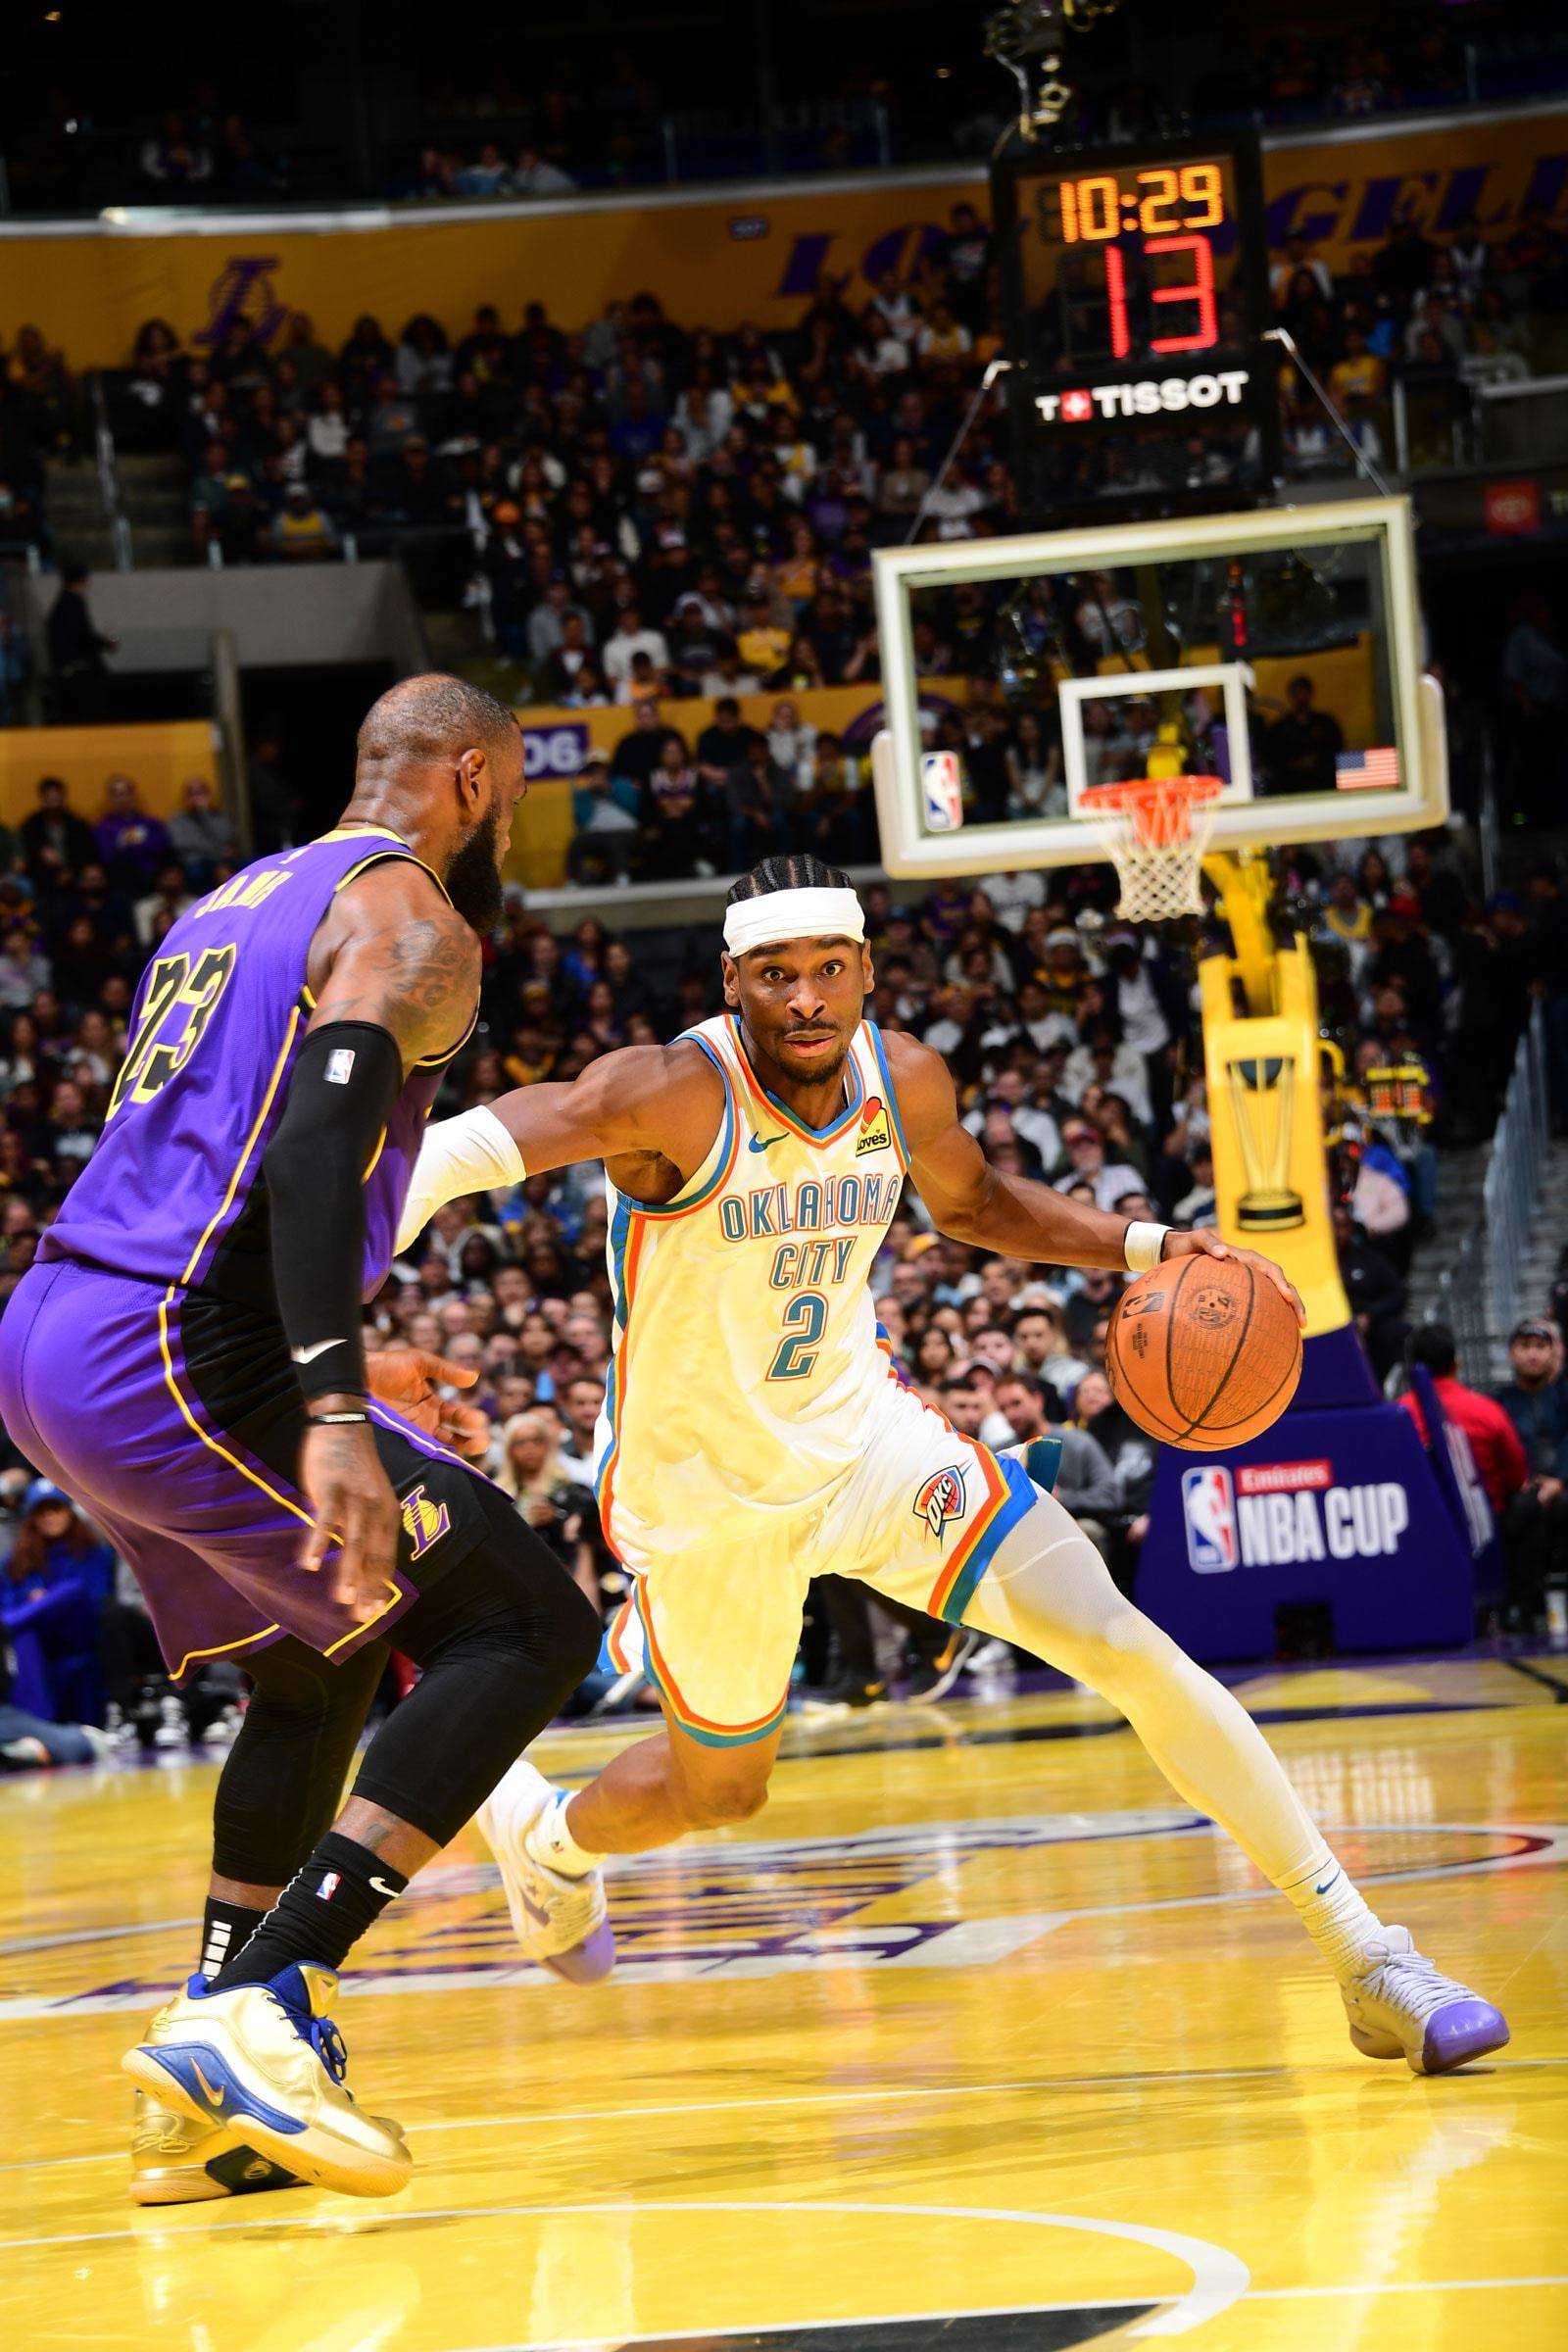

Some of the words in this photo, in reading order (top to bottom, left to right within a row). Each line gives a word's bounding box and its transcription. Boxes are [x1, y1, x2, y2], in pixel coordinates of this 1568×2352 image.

[1059, 164, 1224, 243] 10:29
[1103, 234, 1218, 359] 13
[1092, 370, 1250, 418] TISSOT
[105, 942, 237, 1122] 23
[718, 1173, 901, 1243] OKLAHOMA
[768, 1236, 858, 1291] CITY
[764, 1290, 829, 1382] 2
[925, 1473, 955, 1537] OKC
[1239, 1465, 1330, 1491] Emirates
[1237, 1491, 1326, 1568] NBA
[1324, 1483, 1409, 1559] CUP
